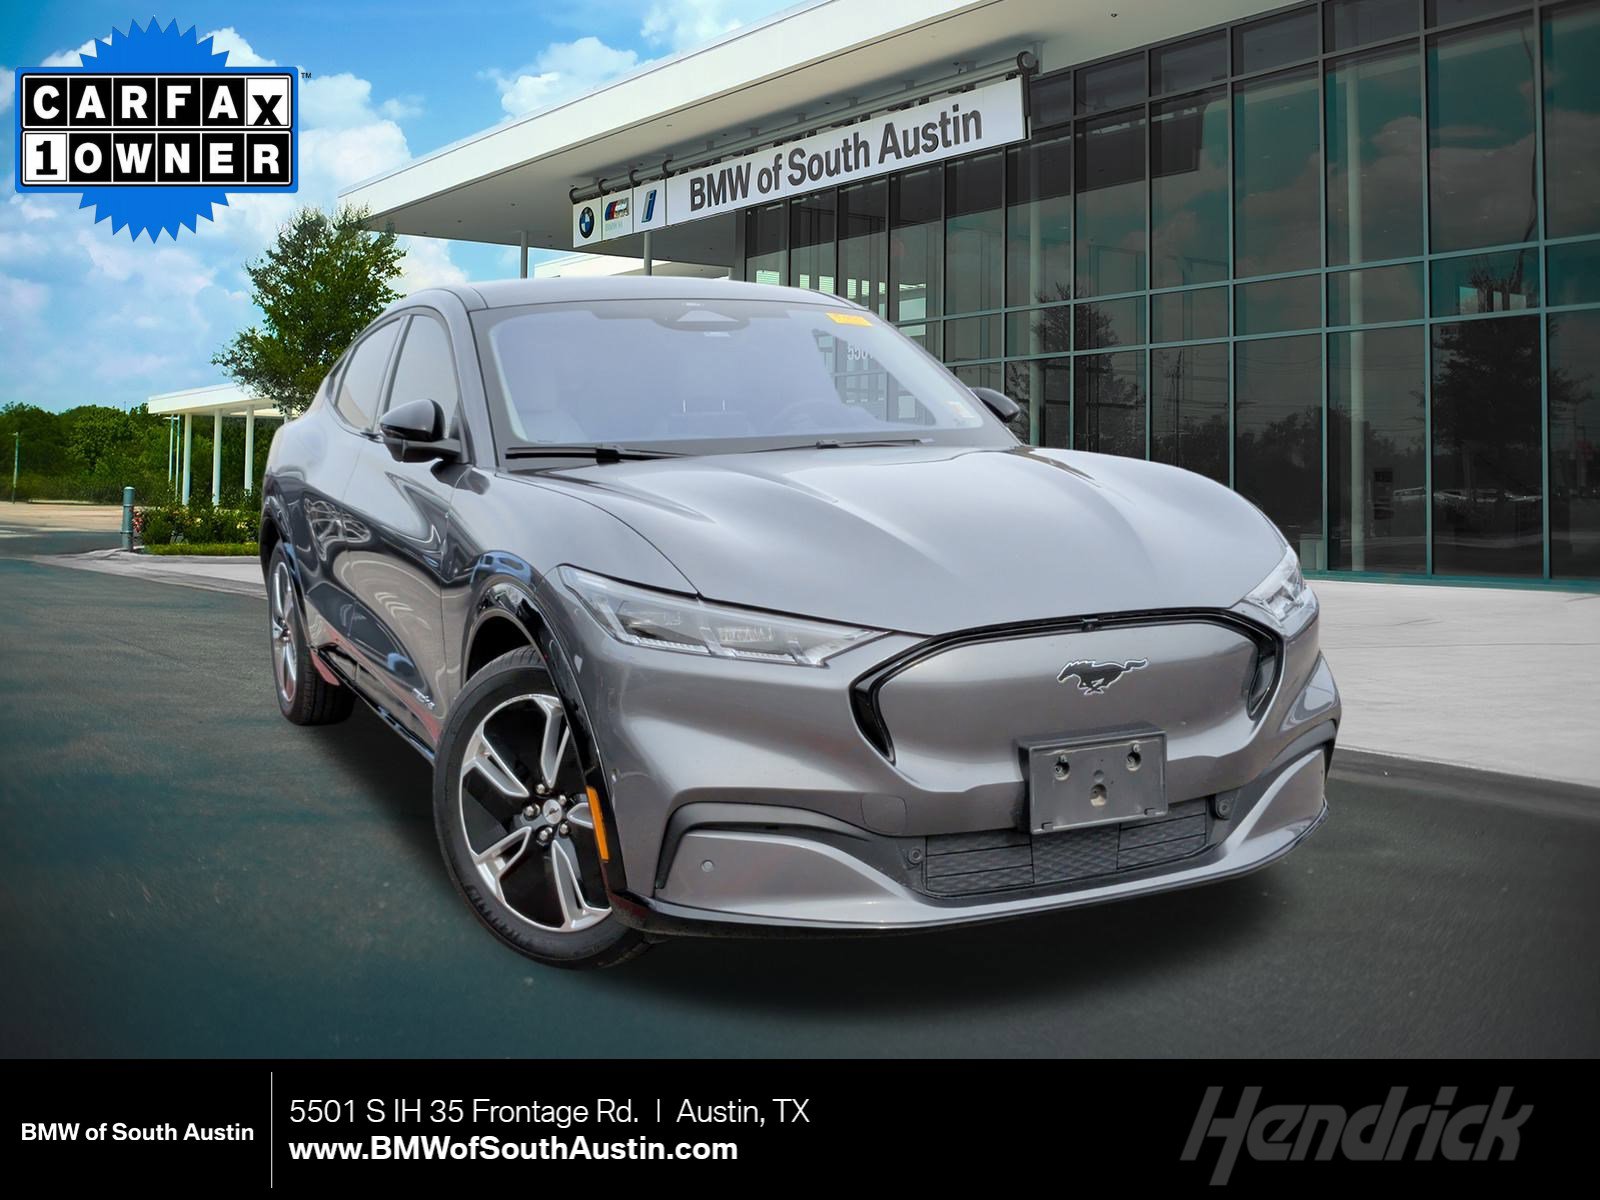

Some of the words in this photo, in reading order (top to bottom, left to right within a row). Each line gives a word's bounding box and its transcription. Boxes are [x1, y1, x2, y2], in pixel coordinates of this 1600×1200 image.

[689, 163, 751, 212] BMW
[757, 153, 783, 194] of
[787, 132, 870, 186] South
[878, 104, 982, 164] Austin
[847, 343, 873, 360] 550
